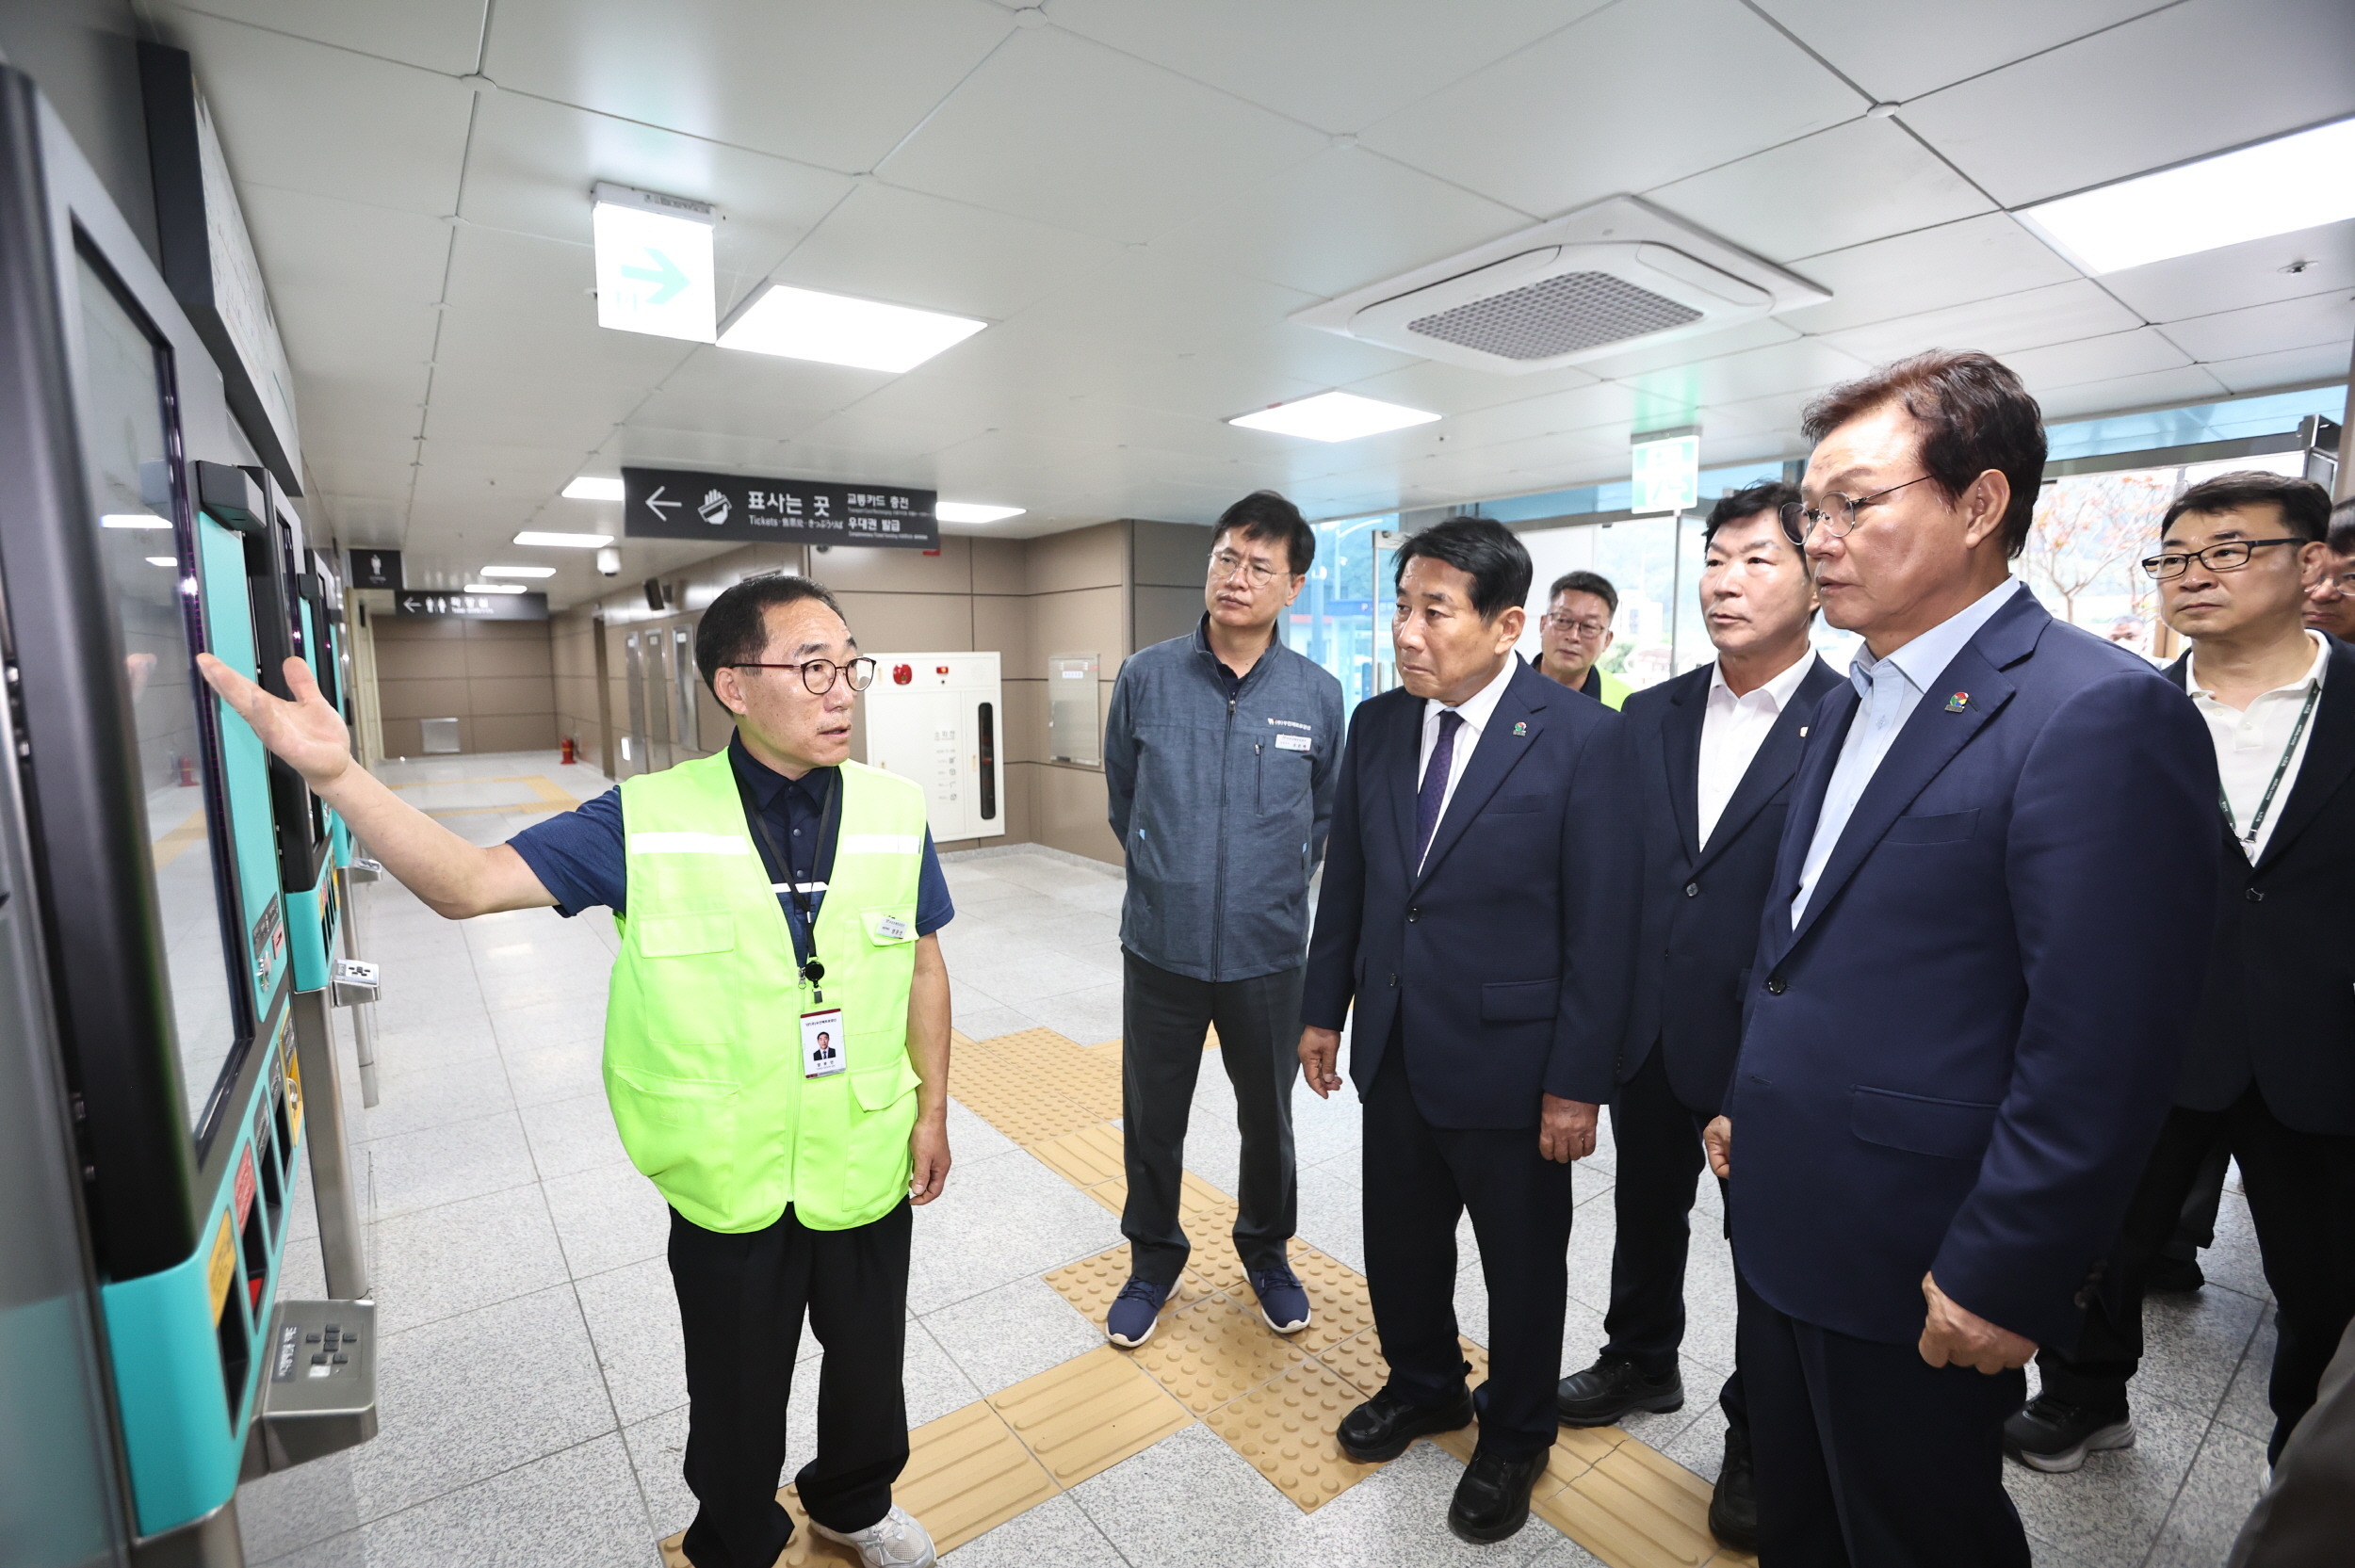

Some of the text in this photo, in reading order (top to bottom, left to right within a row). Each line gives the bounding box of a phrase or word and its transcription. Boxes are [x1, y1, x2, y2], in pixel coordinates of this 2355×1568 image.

[748, 491, 803, 515] 표사는
[813, 495, 830, 517] 곳
[848, 493, 909, 509] 교통카드 충전
[749, 514, 778, 526] Tickets
[849, 517, 901, 532] 우대권 발급
